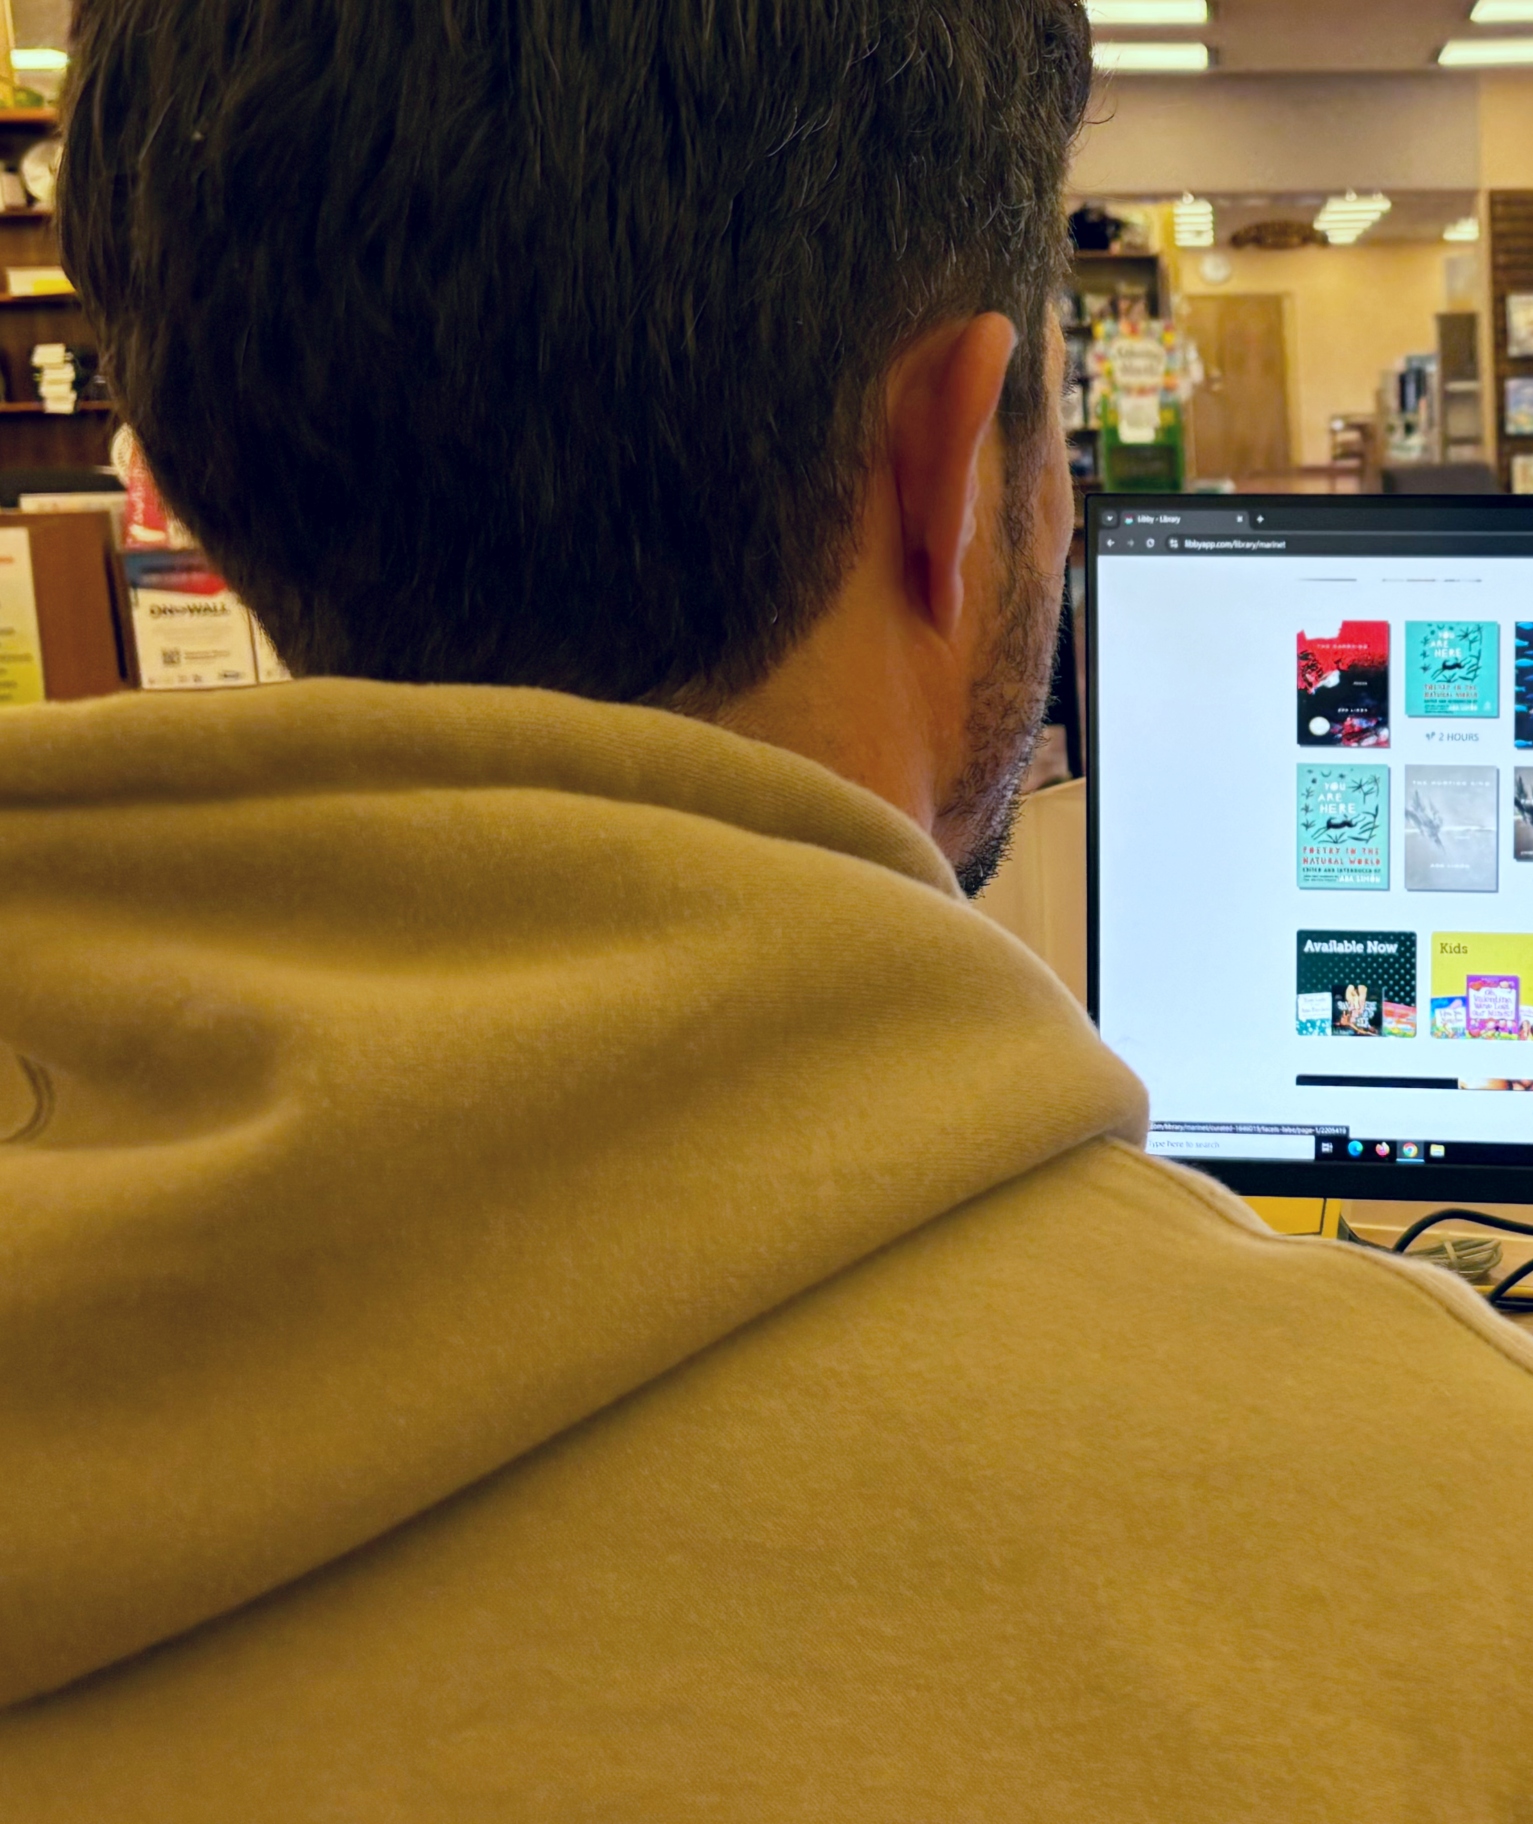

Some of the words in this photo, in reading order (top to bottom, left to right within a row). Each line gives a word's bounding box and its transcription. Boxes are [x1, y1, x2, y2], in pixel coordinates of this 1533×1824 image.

[1137, 515, 1154, 525] Libby
[1159, 515, 1181, 525] Library
[1434, 648, 1462, 659] HERE
[1438, 732, 1444, 741] 2
[1447, 732, 1479, 742] HOURS
[1324, 782, 1346, 791] YOU
[1318, 793, 1342, 802] ARE
[1319, 803, 1356, 814] HERE
[1302, 846, 1340, 855] POETRY
[1302, 857, 1344, 865] NATURAL
[1349, 858, 1380, 866] WORLD
[1304, 940, 1365, 954] Available
[1366, 940, 1399, 954] Now
[1440, 942, 1468, 954] Kids
[1167, 1140, 1184, 1148] here
[1196, 1141, 1220, 1149] search
